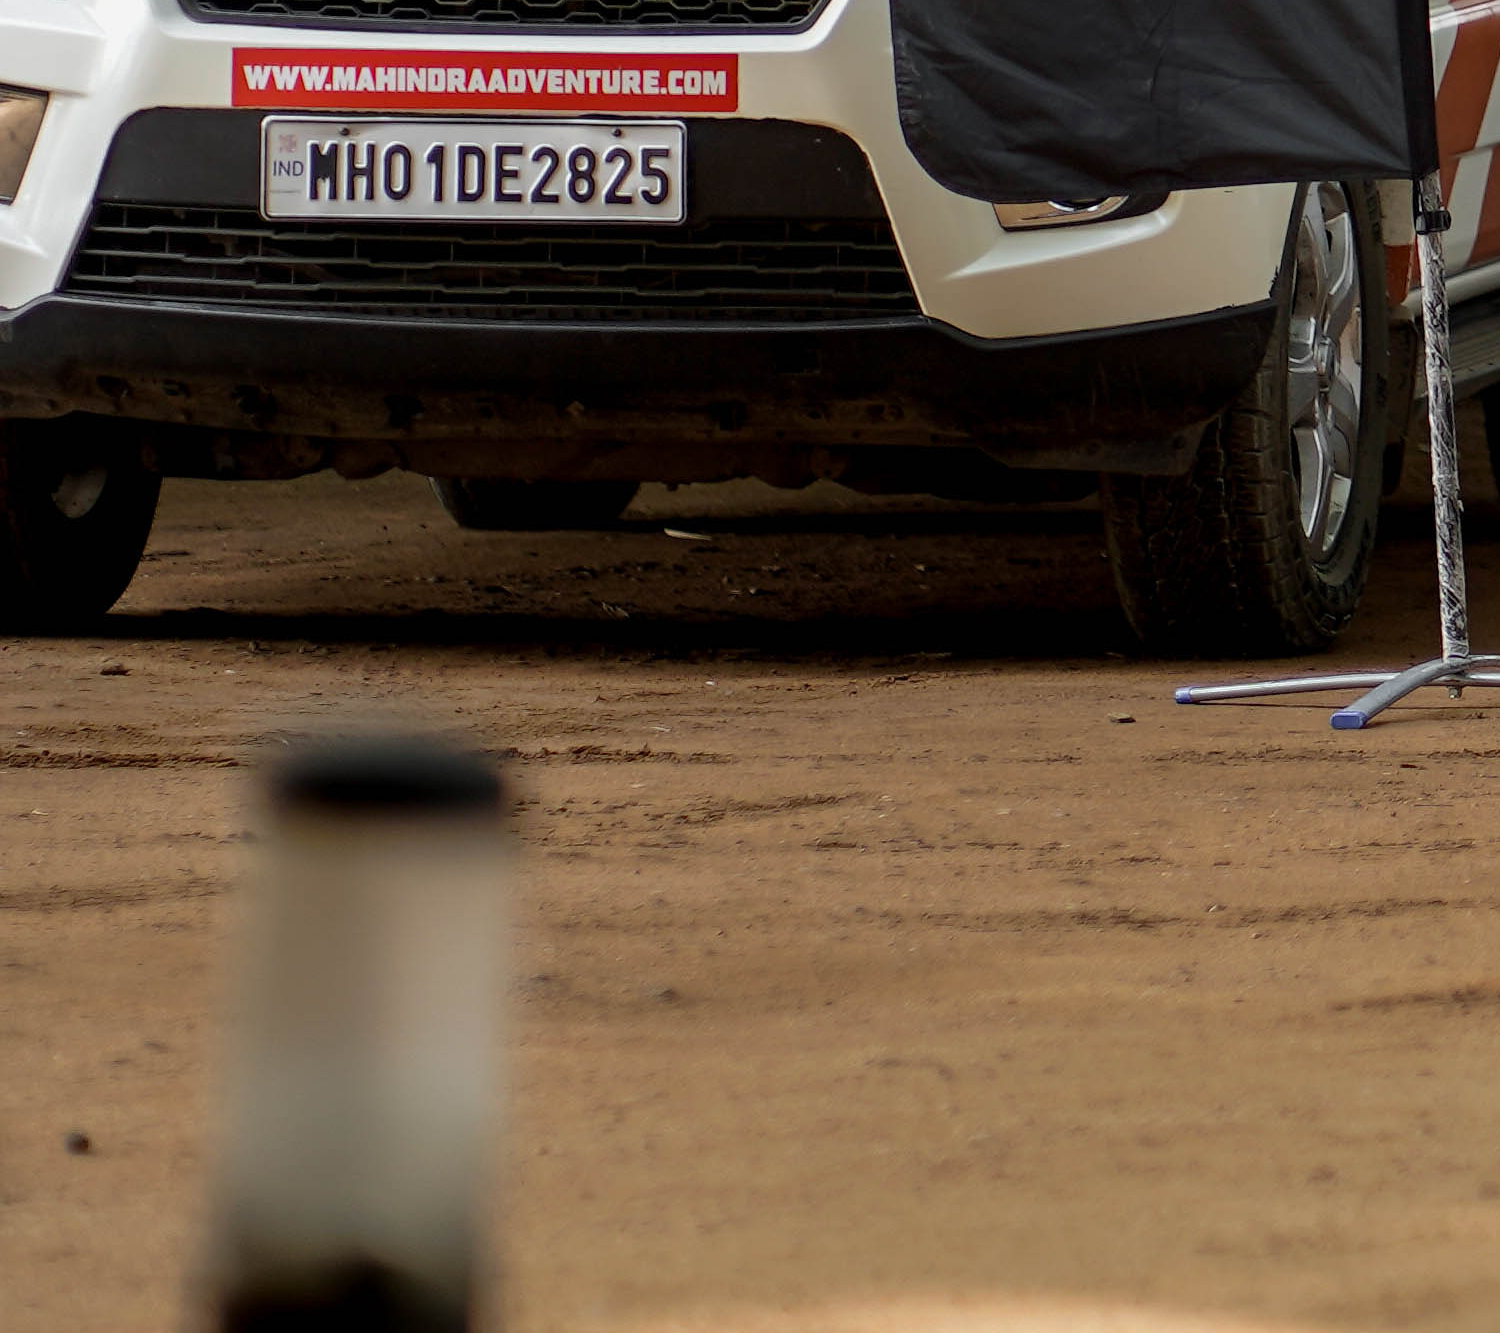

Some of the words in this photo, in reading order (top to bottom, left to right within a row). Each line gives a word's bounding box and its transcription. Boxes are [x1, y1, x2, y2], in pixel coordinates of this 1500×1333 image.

[243, 64, 728, 97] WWW.MAHINDRAADVENTURE.COM
[272, 159, 305, 178] IND
[307, 140, 671, 206] MH01DE2825
